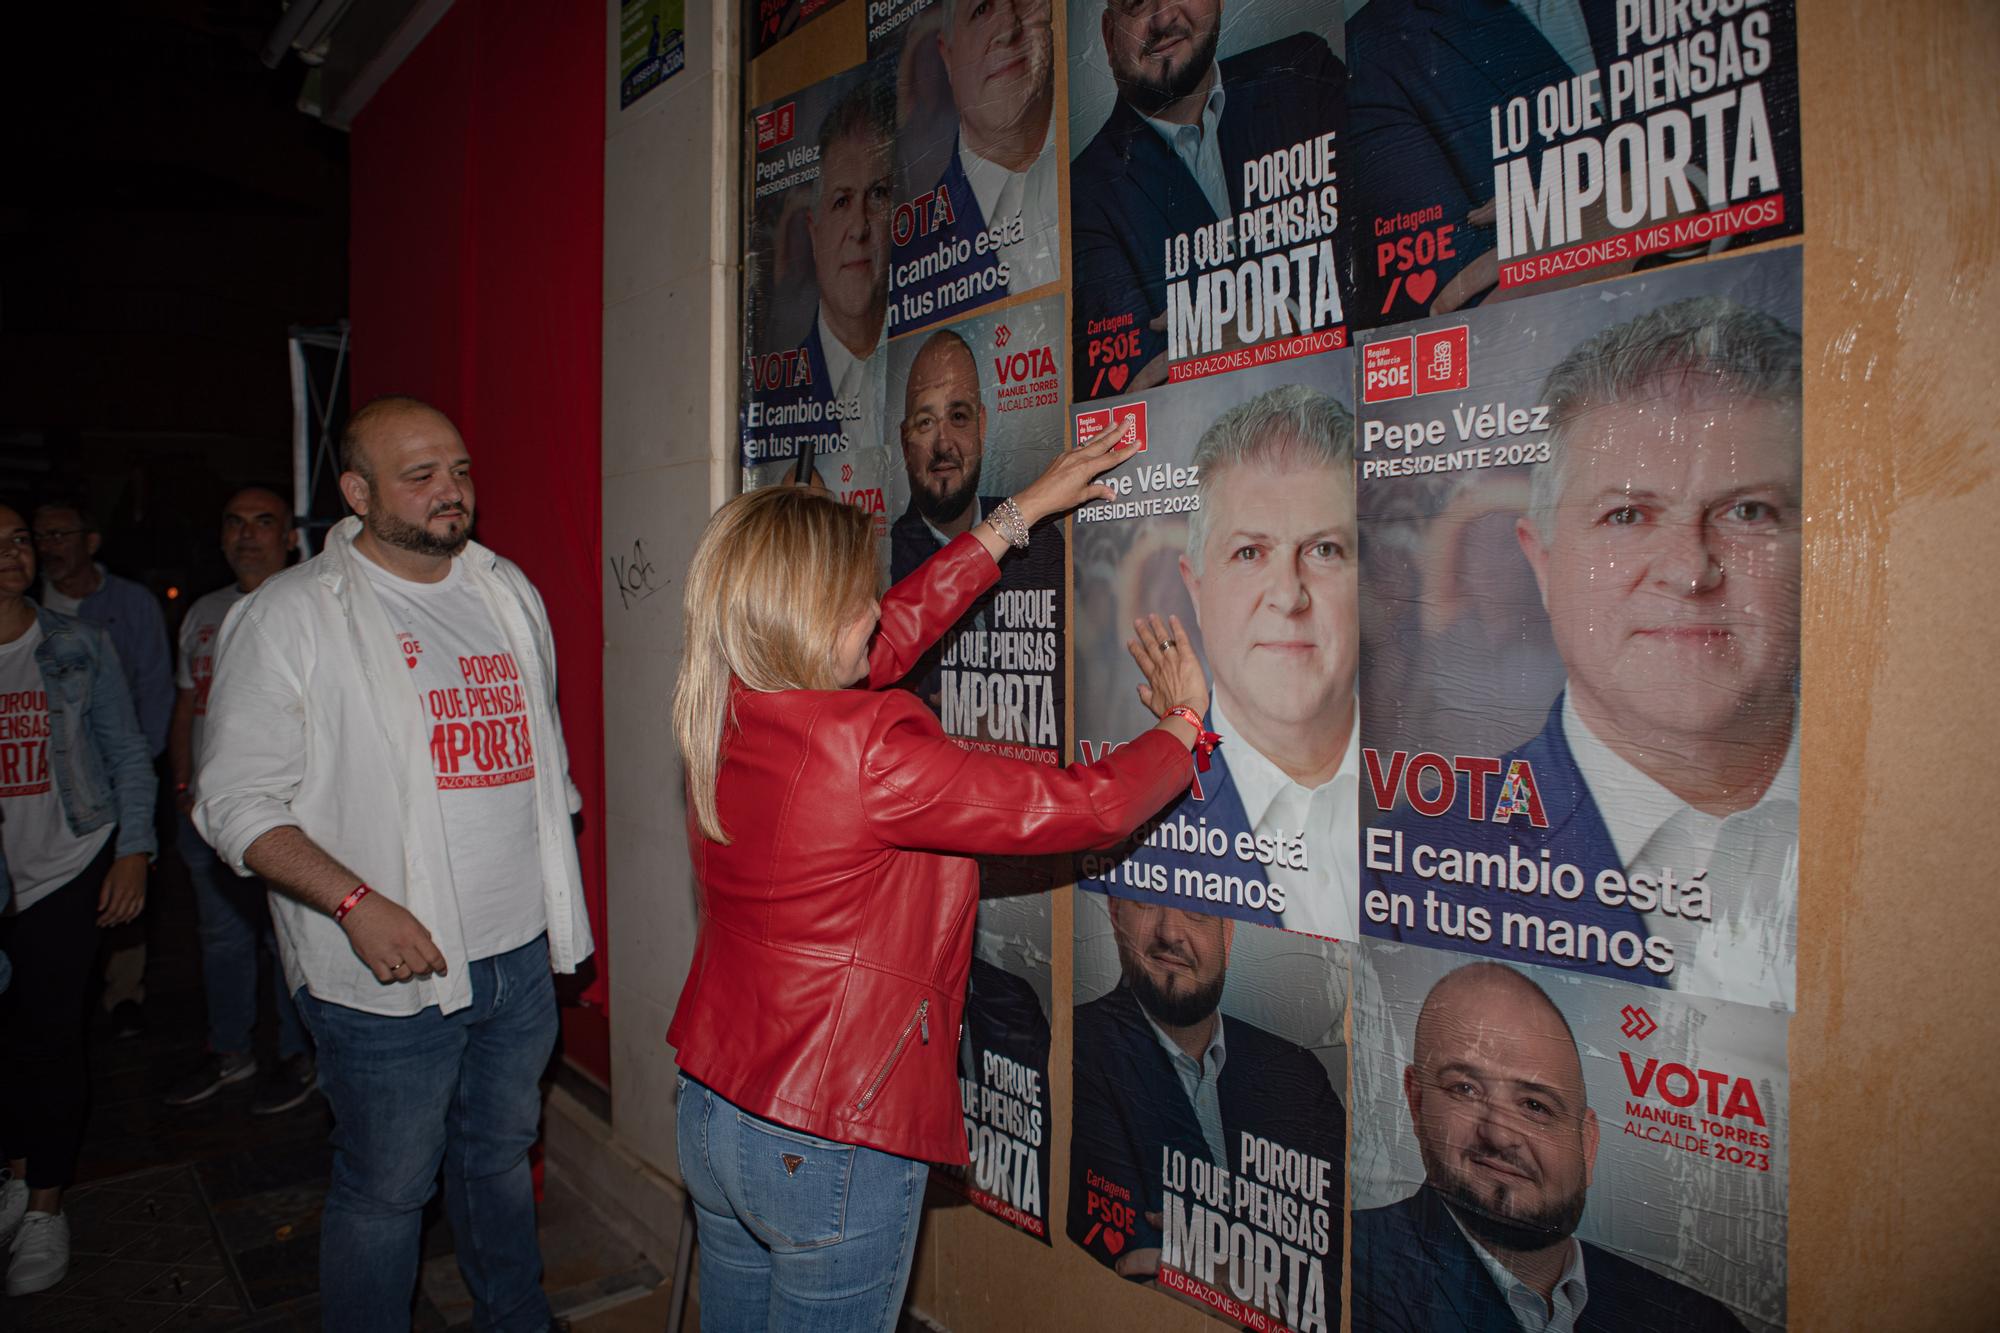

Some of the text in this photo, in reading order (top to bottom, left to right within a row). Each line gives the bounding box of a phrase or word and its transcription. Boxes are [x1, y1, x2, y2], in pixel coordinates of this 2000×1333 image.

[1490, 10, 1772, 160] LO QUE PIENSAS
[756, 145, 820, 182] Pepe Vélez
[1243, 131, 1337, 209] PORQUE
[1494, 80, 1780, 261] IMPORTA
[892, 184, 955, 247] OTA
[1164, 184, 1339, 280] LO QUE PIENSAS
[1374, 204, 1443, 237] Cartagena
[896, 236, 971, 288] cambio
[975, 208, 1024, 256] está
[1377, 224, 1456, 278] PSOE
[1503, 201, 1779, 285] TUS RAZONES, MIS MOTIVOS
[902, 291, 934, 321] tus
[937, 261, 1009, 310] manos
[1166, 238, 1344, 361] IMPORTA
[1087, 312, 1134, 335] Cartagena
[1088, 328, 1142, 368] PSOE
[751, 347, 813, 391] VOTA
[995, 346, 1057, 385] VOTA
[1171, 330, 1343, 381] TUS RAZONES, MIS MOTIVOS
[1367, 365, 1410, 390] PSOE
[1368, 347, 1391, 358] Región
[747, 401, 764, 428] El
[765, 396, 823, 426] cambio
[997, 379, 1058, 399] MANUEL TORRES
[997, 391, 1058, 412] ALCALDE 2023
[743, 438, 767, 458] en
[769, 433, 792, 457] tus
[1363, 401, 1550, 454] Pepe Vélez
[1137, 463, 1200, 493] Vélez
[1363, 441, 1551, 480] PRESIDENTE 2023
[1078, 494, 1201, 523] PRESIDENTE 2023
[994, 589, 1057, 629] PORQUE
[403, 641, 423, 654] OE
[458, 653, 519, 685] PORQU
[960, 630, 987, 667] QUE
[990, 632, 1056, 672] PIENSAS
[428, 688, 467, 720] QUE
[465, 683, 526, 717] PIENSA
[941, 670, 1058, 746] IMPORTA
[430, 715, 534, 774] MPORTA
[999, 745, 1013, 759] MIS
[1015, 748, 1057, 765] MOTIVOS
[1363, 748, 1550, 829] VOTA
[1131, 815, 1309, 870] ambio está
[1121, 857, 1169, 892] tus
[1174, 865, 1287, 914] manos
[1366, 827, 1713, 922] El cambio está
[1365, 888, 1678, 974] en tus manos
[984, 1049, 1042, 1108] PORQUE
[1618, 1051, 1767, 1127] VOTA
[961, 1078, 1042, 1148] UE PIENSAS
[1625, 1101, 1771, 1149] MANUEL TORRES
[964, 1117, 1042, 1219] PORTA
[1241, 1131, 1331, 1208] PORQUE
[1624, 1121, 1769, 1172] ALCALDE 2023
[1086, 1168, 1131, 1202] Cartagena
[1163, 1145, 1330, 1256] LO QUE PIENSAS
[1087, 1190, 1137, 1236] PSOE
[1161, 1188, 1328, 1333] IMPORTA
[1162, 1268, 1185, 1291] TUS
[1185, 1279, 1243, 1322] RAZONES,
[1243, 1310, 1266, 1331] MIS
